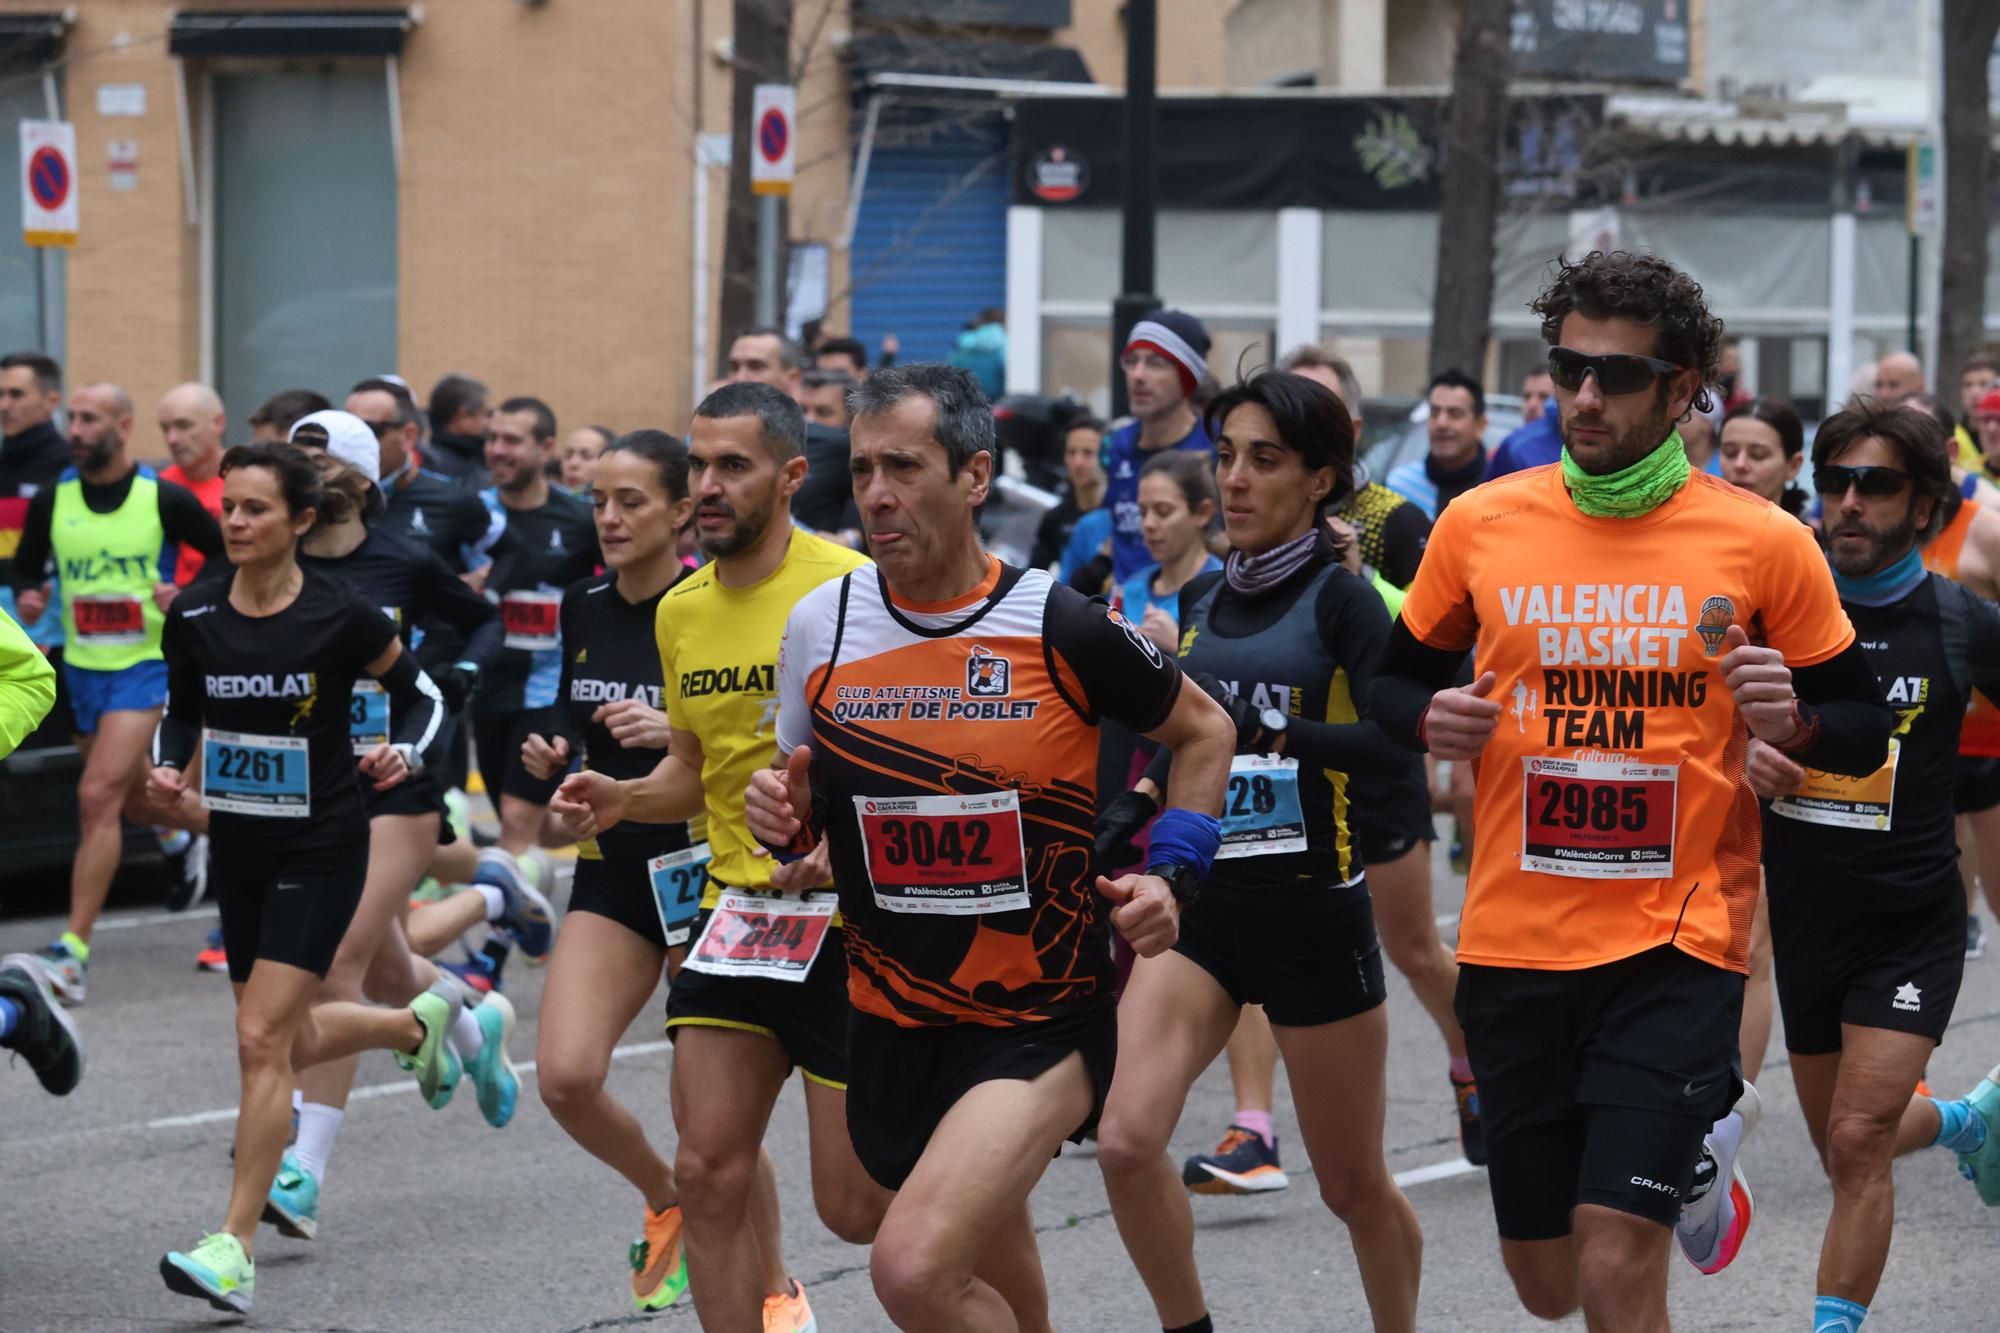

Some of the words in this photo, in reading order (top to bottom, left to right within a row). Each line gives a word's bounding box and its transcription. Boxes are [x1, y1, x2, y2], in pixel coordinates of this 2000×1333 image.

[1499, 584, 1688, 625] VALENCIA
[1537, 627, 1688, 667] BASKET
[205, 673, 311, 698] REDOLAT
[571, 679, 660, 708] REDOLAT
[681, 665, 775, 699] REDOLAT
[836, 686, 871, 699] CLUB
[875, 687, 961, 700] ATLETISME
[1542, 669, 1709, 709] RUNNING
[1878, 675, 1921, 703] AT
[833, 701, 905, 723] QUART
[909, 701, 941, 721] DE
[945, 701, 1040, 721] POBLET
[1543, 709, 1645, 749] TEAM
[218, 746, 285, 784] 2261
[1539, 780, 1648, 832] 2985
[881, 819, 993, 867] 3042
[1554, 848, 1624, 860] #ValènciaCorre
[904, 885, 975, 897] #ValènciaCorre
[1630, 1176, 1675, 1195] CRAFT
